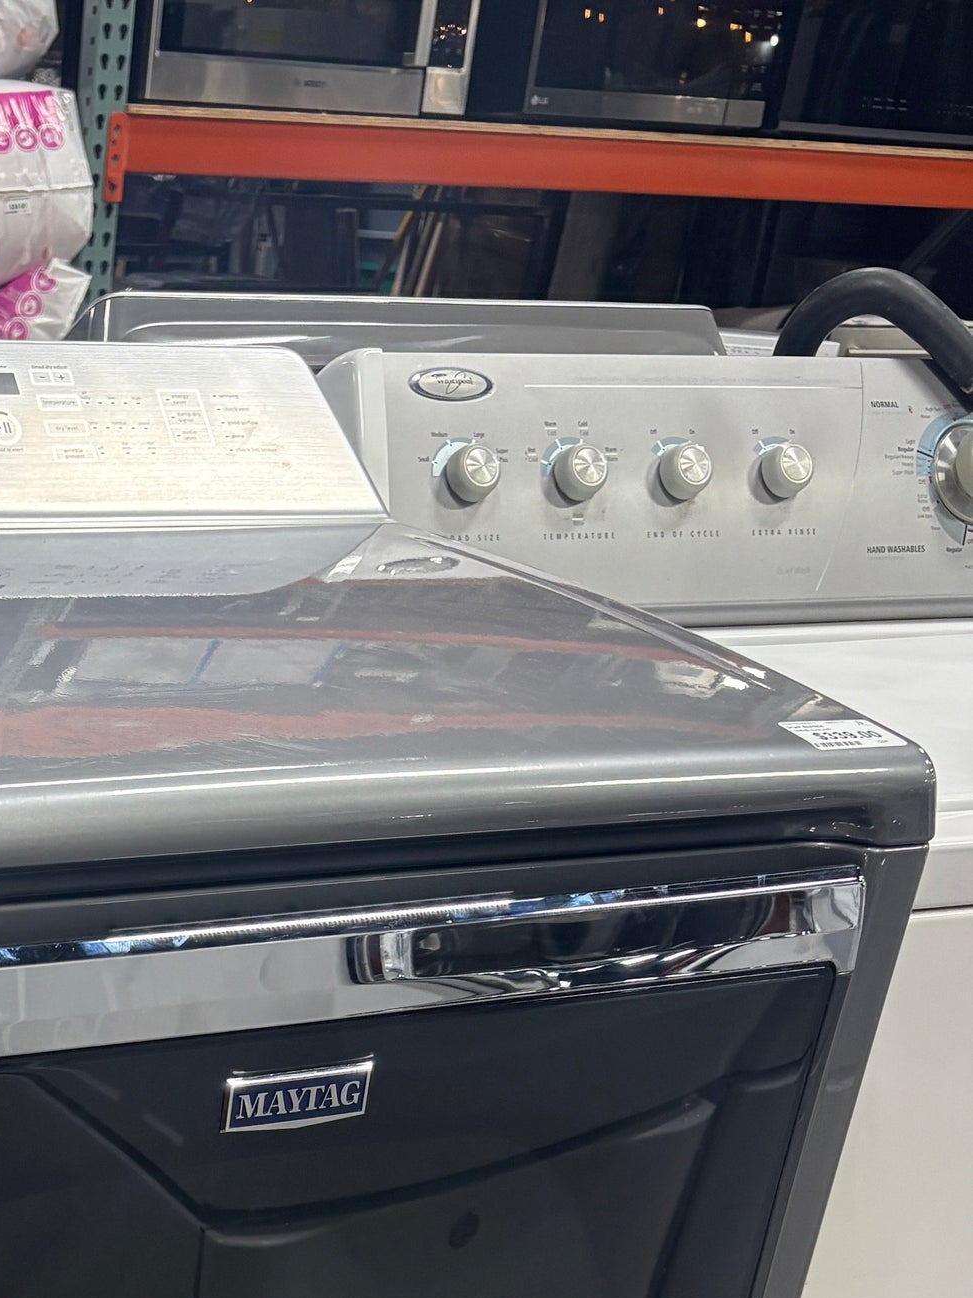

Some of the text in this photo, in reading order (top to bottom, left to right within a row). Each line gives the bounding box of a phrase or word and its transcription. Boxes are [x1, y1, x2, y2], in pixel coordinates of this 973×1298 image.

[870, 401, 899, 409] NORMAL
[543, 532, 616, 540] TEMPERATURE
[647, 530, 720, 539] END OF CYCLE
[752, 528, 817, 537] EXTRA RINSE
[450, 534, 500, 542] OAD SIZE
[887, 545, 925, 553] WASHABLES
[235, 1080, 361, 1120] MAYTAG
